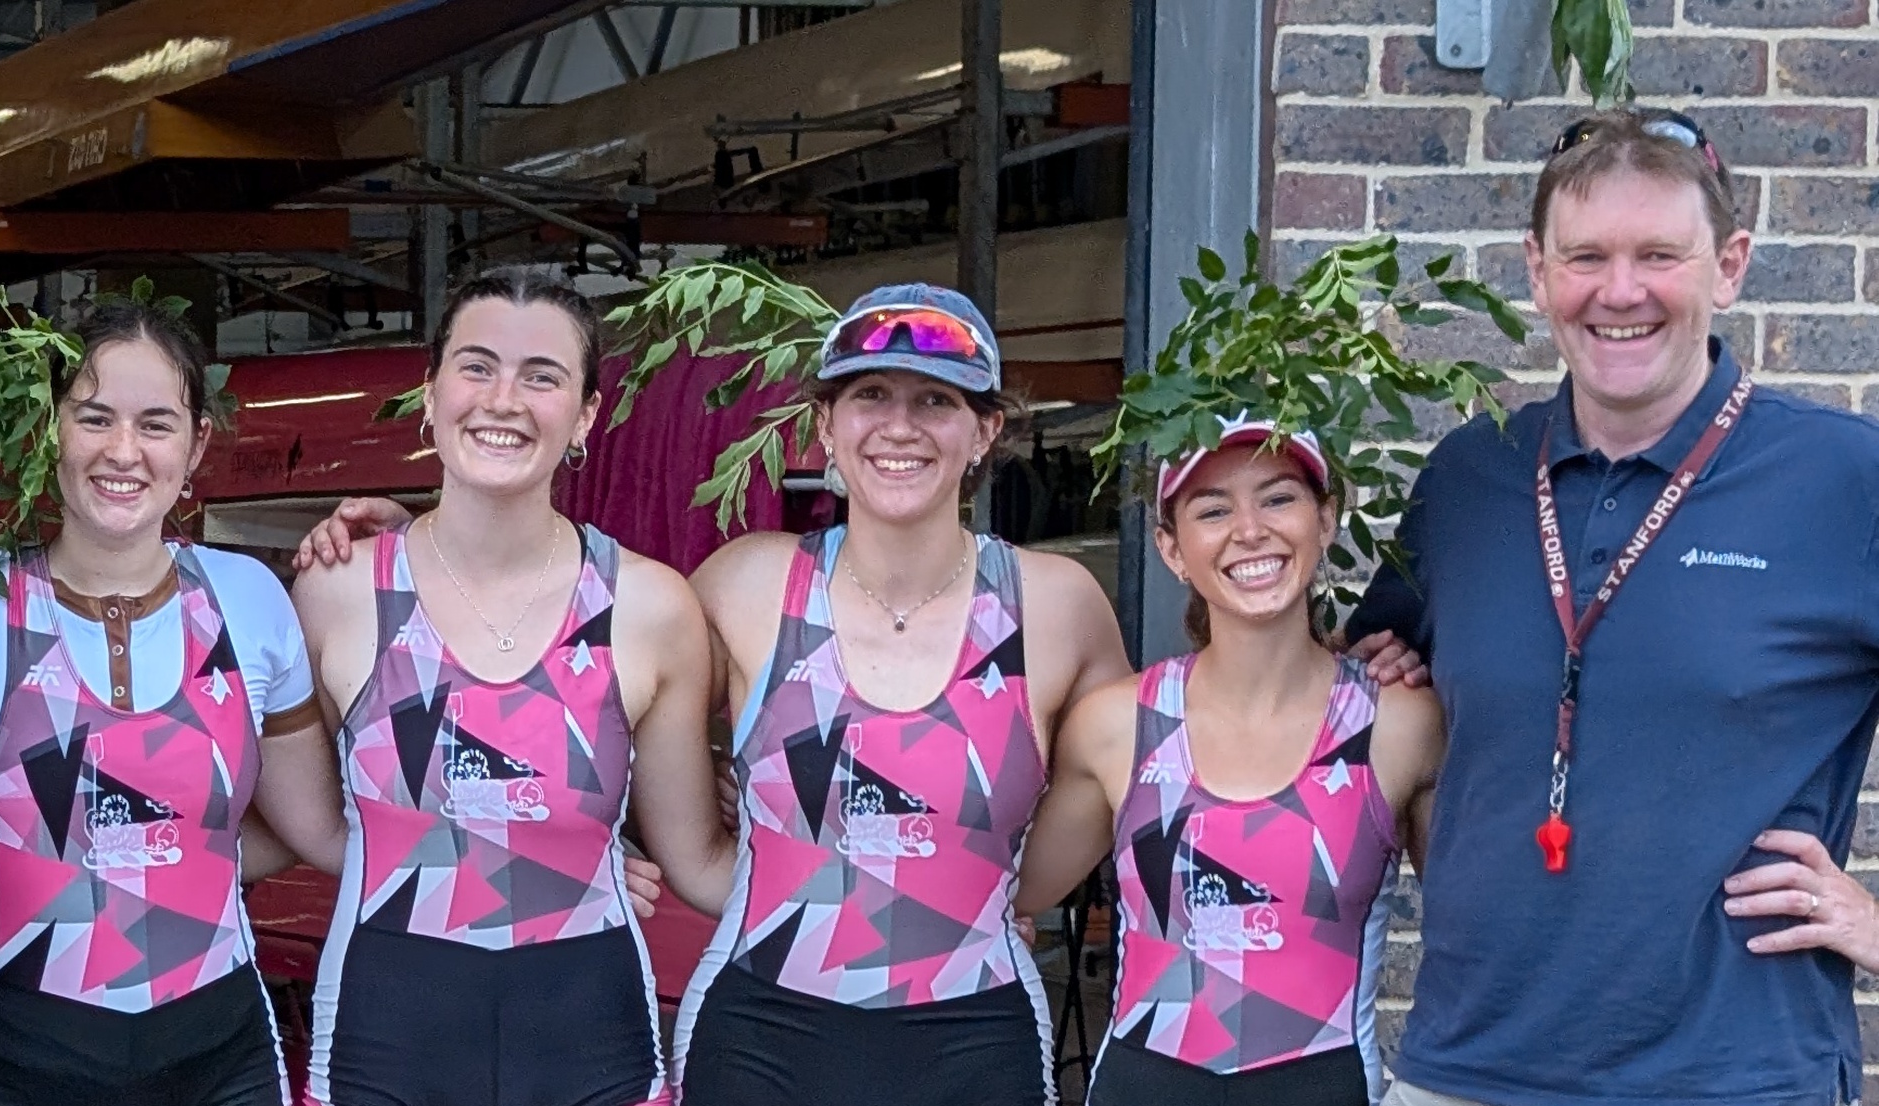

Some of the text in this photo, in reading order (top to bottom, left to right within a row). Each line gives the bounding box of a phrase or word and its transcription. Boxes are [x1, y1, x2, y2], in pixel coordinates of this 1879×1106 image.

[1537, 464, 1566, 582] STANFORD
[1598, 484, 1682, 604] STANFORD
[1699, 550, 1767, 570] MathWorks
